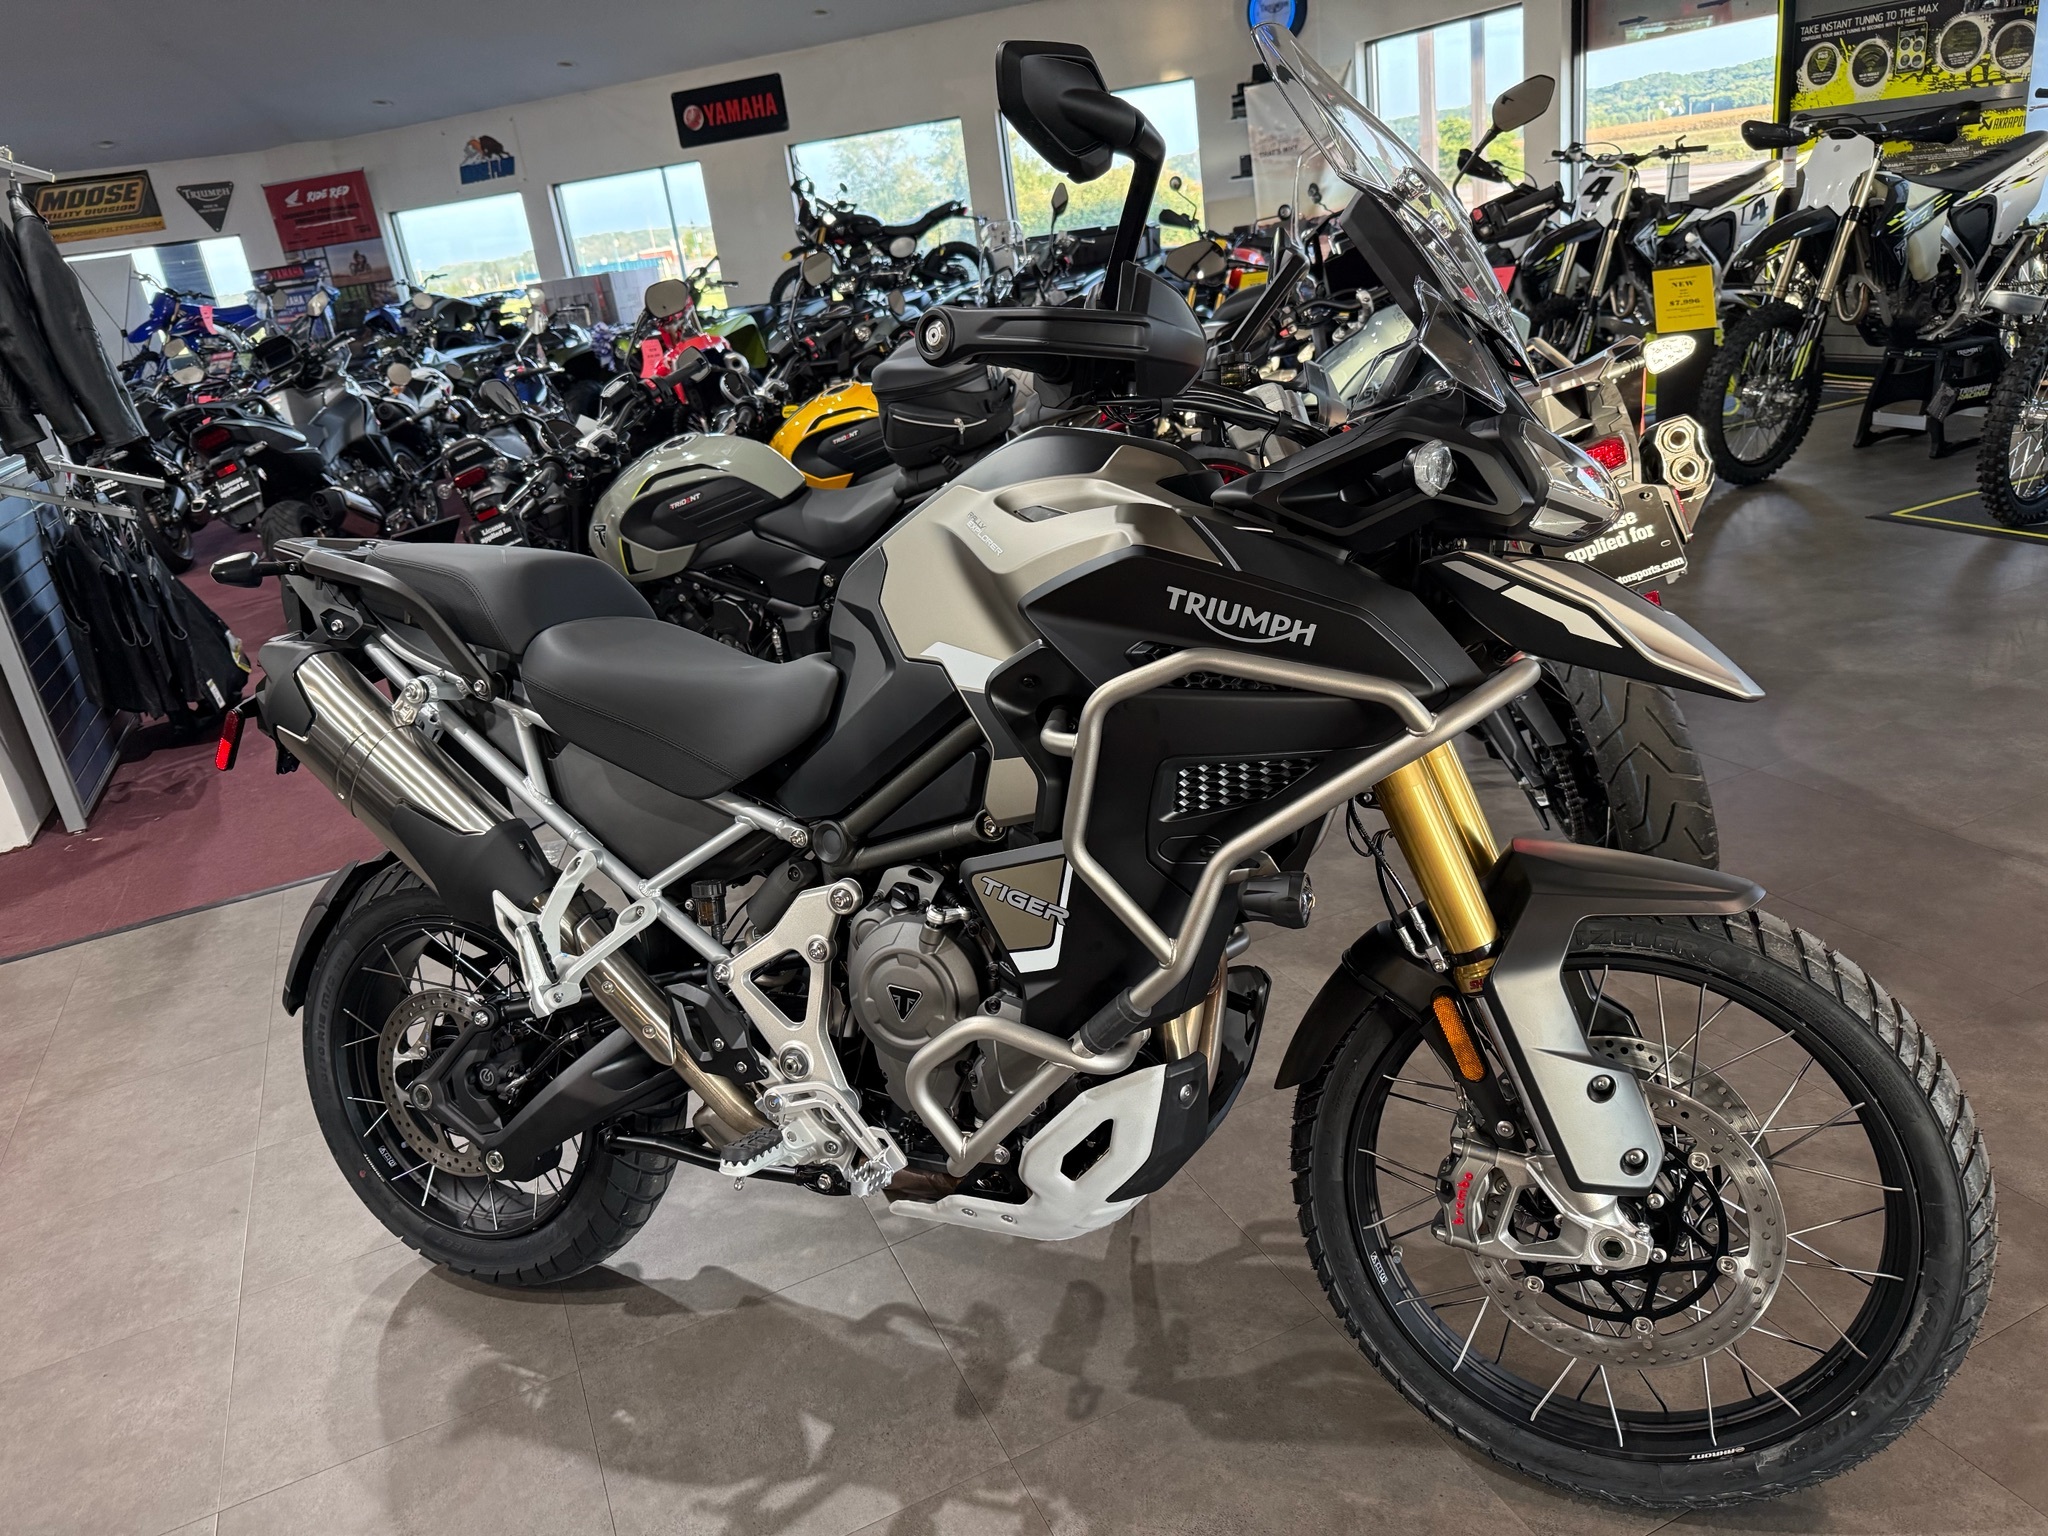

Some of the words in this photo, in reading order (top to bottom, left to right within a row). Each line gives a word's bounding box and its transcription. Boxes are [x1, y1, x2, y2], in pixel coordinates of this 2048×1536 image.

[1801, 24, 1819, 36] TAKE
[1821, 18, 1853, 32] INSTANT
[1855, 13, 1884, 26] TUNING
[1886, 10, 1897, 20] TO
[1900, 7, 1916, 18] THE
[1918, 3, 1939, 15] MAX
[1867, 23, 1884, 31] SECONDS
[703, 92, 779, 127] YAMAHA
[41, 182, 139, 212] MOOSE
[182, 187, 231, 200] TRIUMPH
[307, 188, 328, 203] RIDE
[329, 185, 350, 199] RED
[1583, 176, 1615, 203] 4
[84, 204, 136, 216] DIVISION
[1750, 197, 1769, 222] 4
[1671, 280, 1694, 288] NEW
[1959, 383, 1992, 395] TRIUMPH
[832, 429, 859, 445] TRIDENT
[669, 492, 701, 510] TRIDENT
[967, 511, 986, 529] RALLY
[966, 520, 1003, 556] EXPLORER
[1565, 530, 1631, 563] applied
[1629, 524, 1656, 543] for
[1166, 585, 1318, 647] TRIUMPH
[981, 876, 1070, 927] TIGER
[1452, 1171, 1473, 1225] brembo
